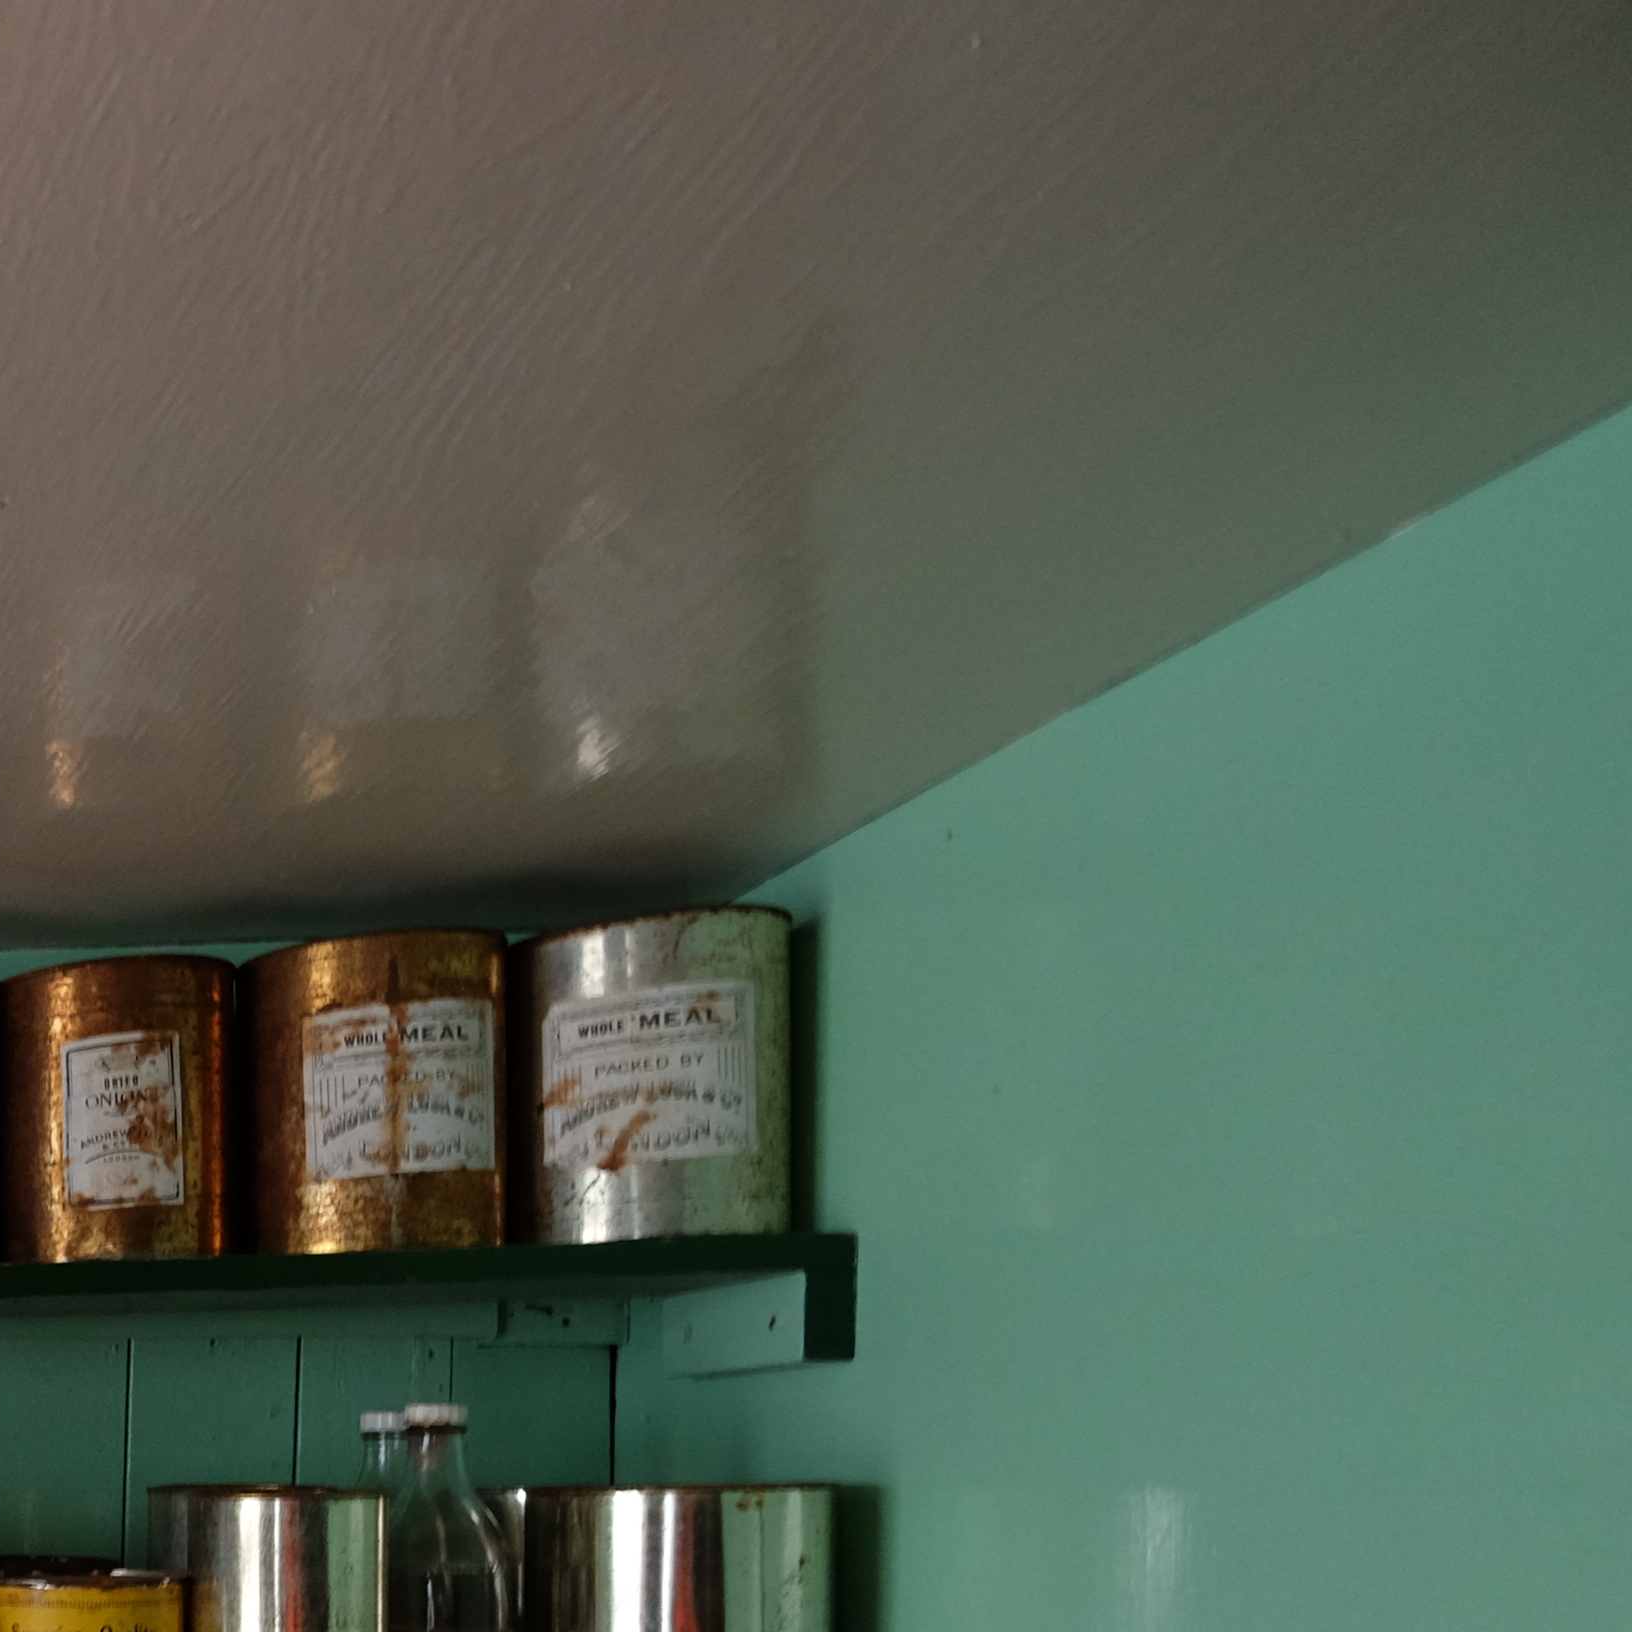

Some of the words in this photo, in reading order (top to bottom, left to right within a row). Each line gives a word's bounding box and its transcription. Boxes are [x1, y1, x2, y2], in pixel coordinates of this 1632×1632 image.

[578, 1019, 625, 1039] WHOLE
[639, 1008, 722, 1031] MEAL
[343, 1033, 387, 1048] WHOLE
[400, 1025, 470, 1042] MEAL
[594, 1055, 669, 1079] PACKED
[680, 1053, 705, 1069] BY
[103, 1075, 139, 1091] DRIED
[358, 1072, 427, 1089] PACED
[436, 1071, 456, 1082] BY
[560, 1082, 639, 1138] ANDREW
